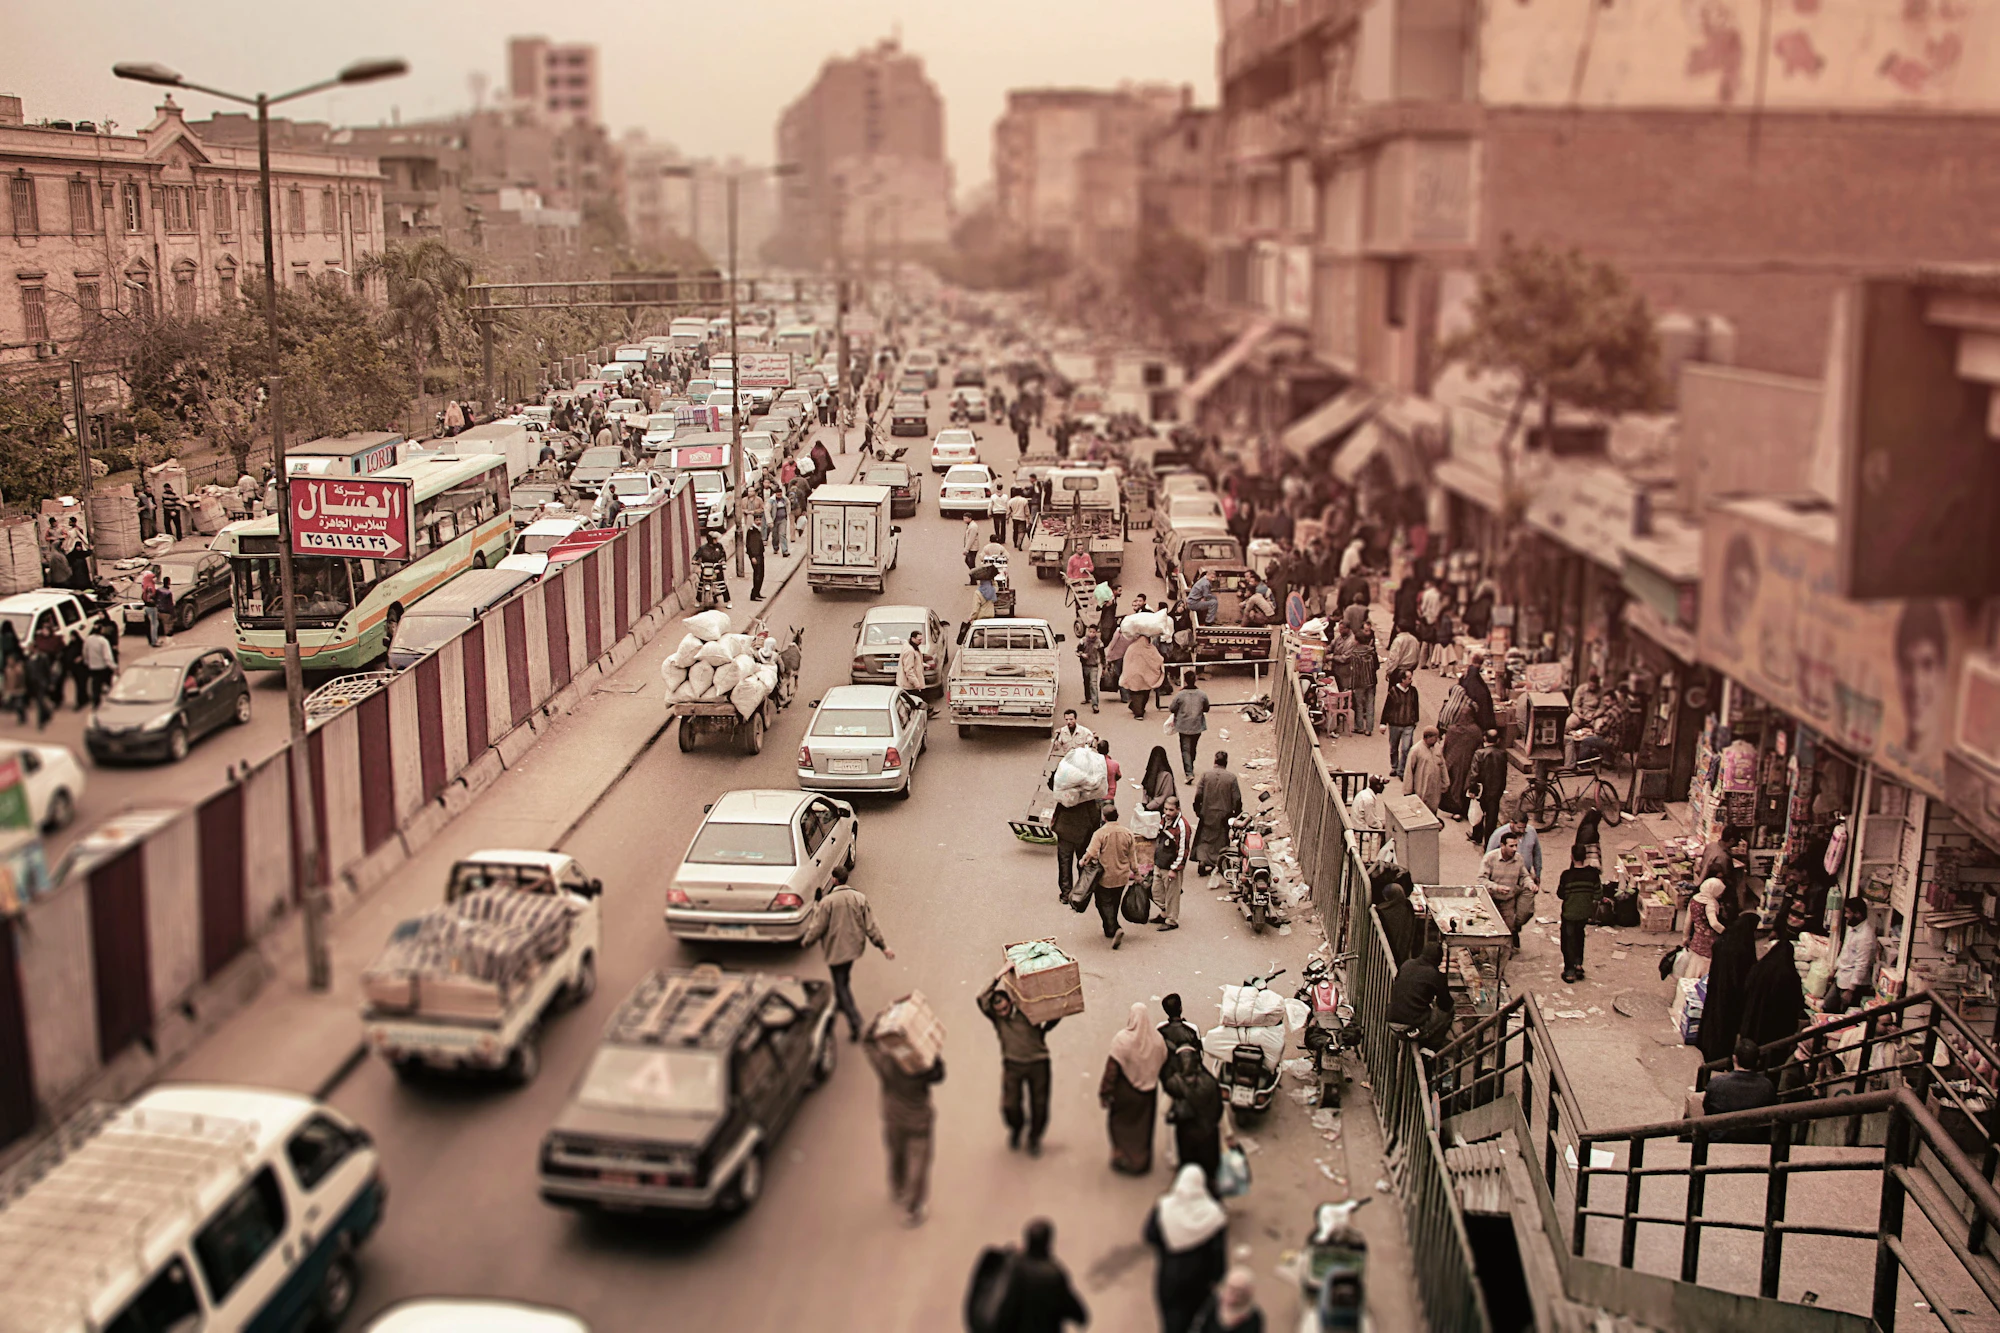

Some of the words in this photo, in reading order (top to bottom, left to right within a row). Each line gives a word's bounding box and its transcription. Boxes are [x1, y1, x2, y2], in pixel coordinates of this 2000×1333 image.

[365, 445, 394, 474] LORD
[333, 484, 366, 497] شركة
[298, 482, 400, 520] العسال
[319, 515, 352, 531] الجاهزة
[352, 519, 387, 532] للملابس
[969, 686, 1034, 697] NISSAN
